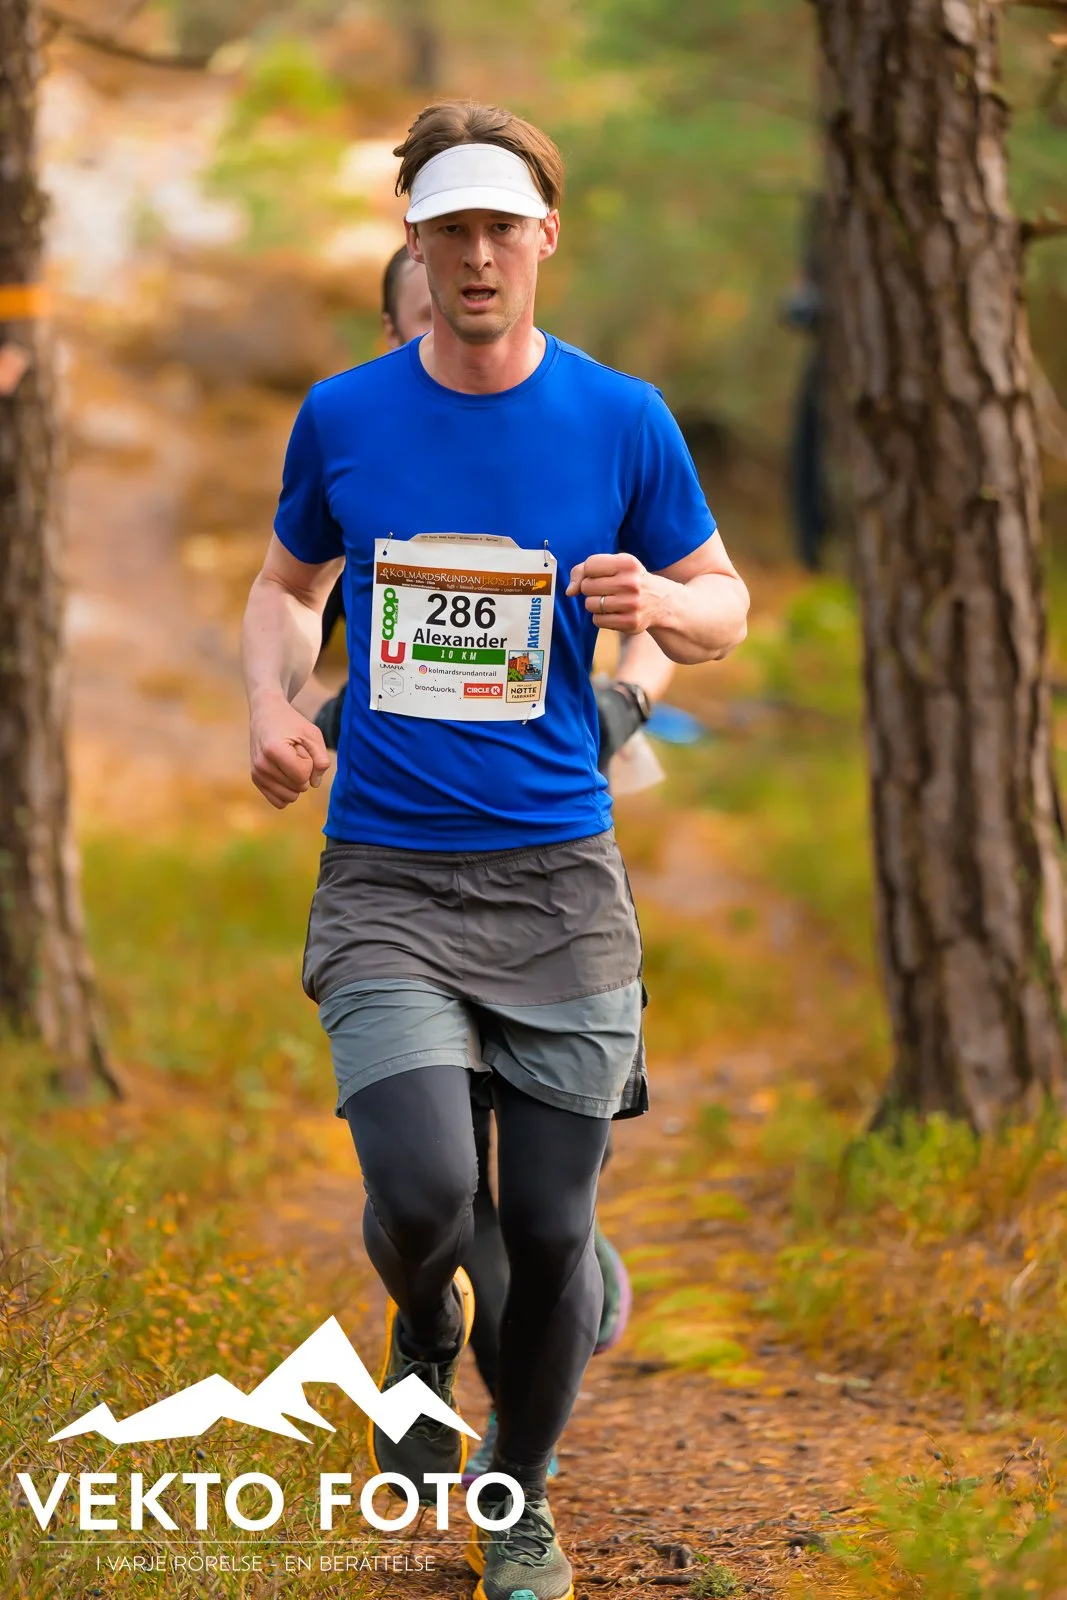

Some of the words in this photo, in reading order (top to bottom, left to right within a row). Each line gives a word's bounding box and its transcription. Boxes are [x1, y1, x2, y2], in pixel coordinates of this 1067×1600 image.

[382, 587, 399, 640] coop
[425, 593, 497, 630] 286
[527, 597, 542, 649] Aktivitus
[413, 628, 508, 648] Alexander
[441, 650, 454, 659] 10
[461, 651, 477, 661] KM
[379, 663, 405, 671] UMARA
[428, 668, 497, 677] kolmardsrundantrail
